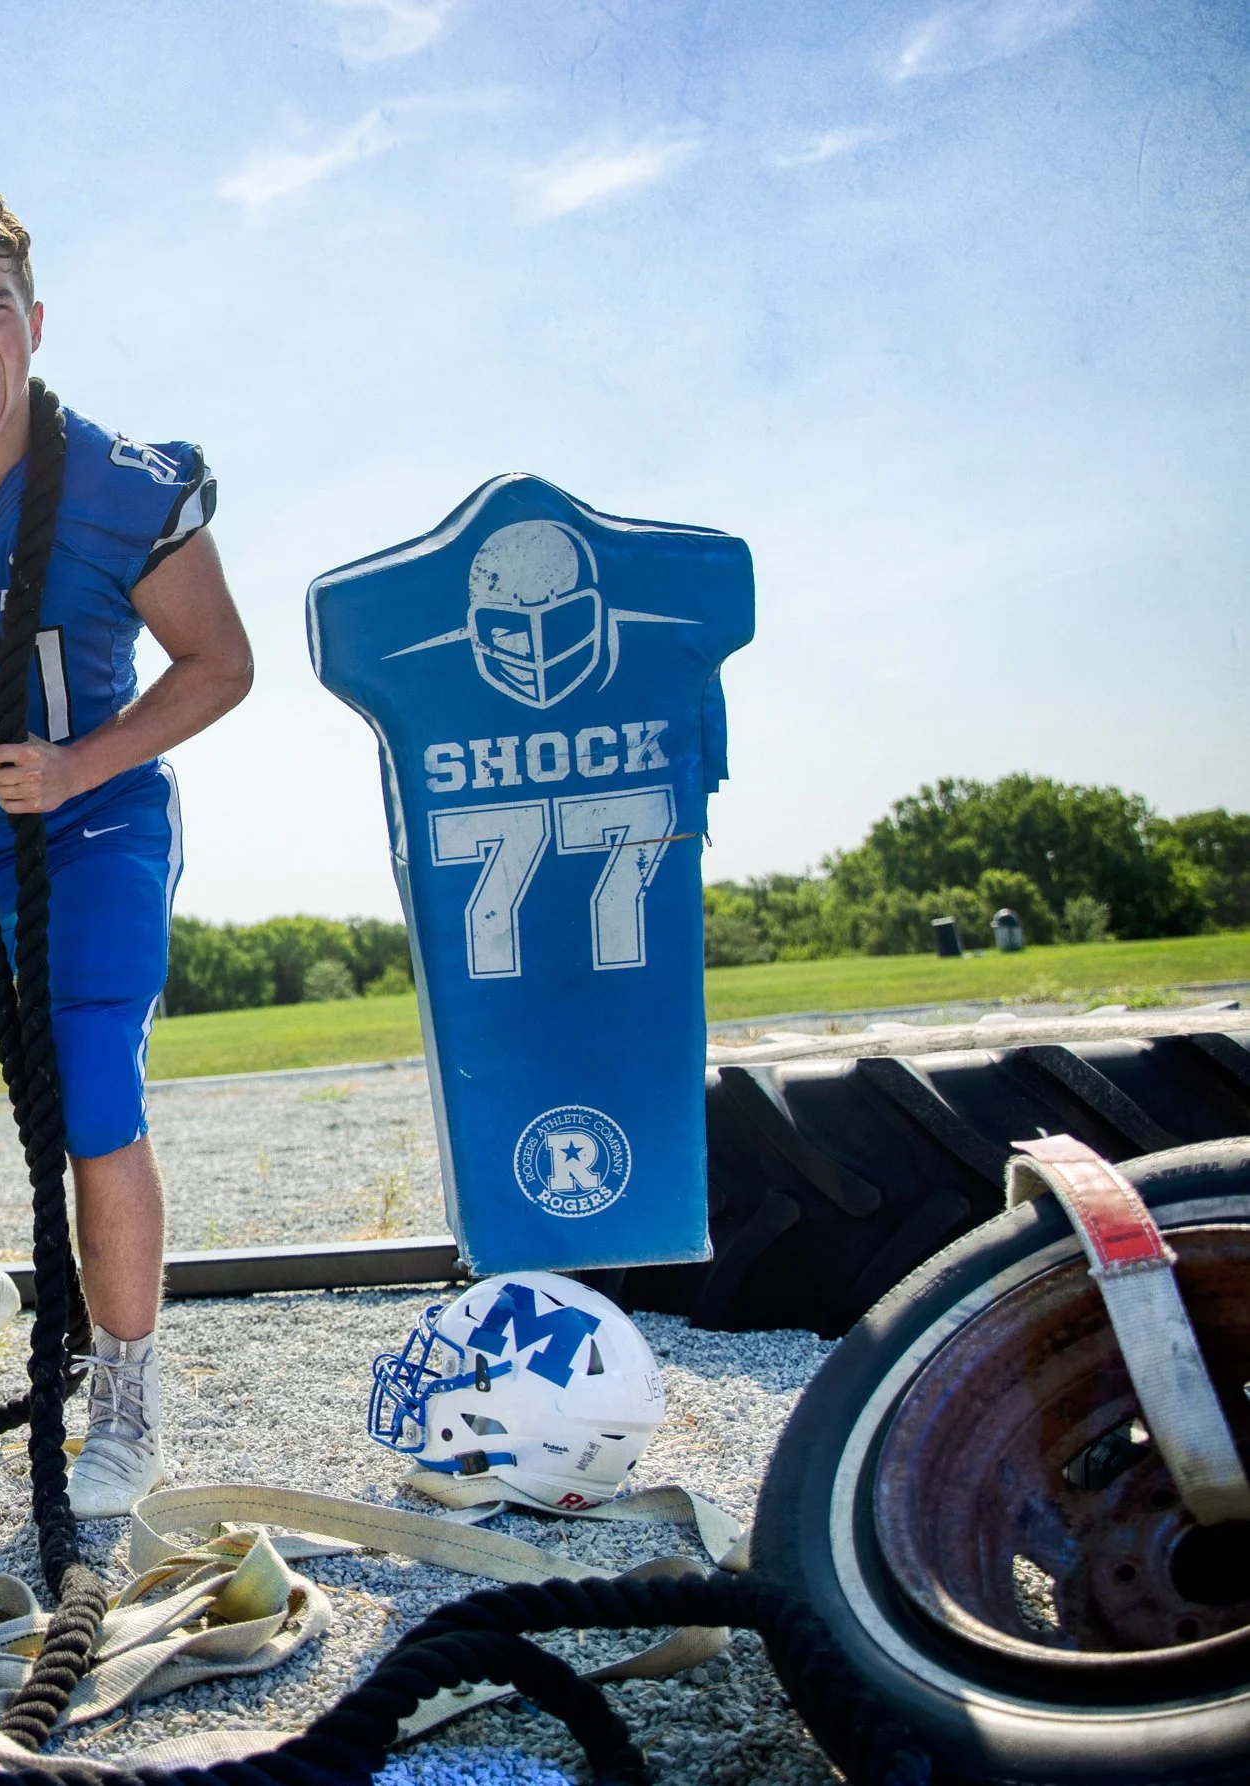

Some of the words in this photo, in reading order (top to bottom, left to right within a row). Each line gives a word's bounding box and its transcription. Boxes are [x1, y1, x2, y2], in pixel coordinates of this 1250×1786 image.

[423, 719, 670, 793] SHOCK
[427, 783, 678, 980] 77
[522, 1136, 539, 1183] ROGERS
[536, 1113, 591, 1138] ATHLETIC
[593, 1120, 624, 1176] COMPANY
[544, 1130, 601, 1192] R
[537, 1185, 613, 1212] ROGERS
[466, 1282, 602, 1389] M
[542, 1442, 569, 1453] Riddell
